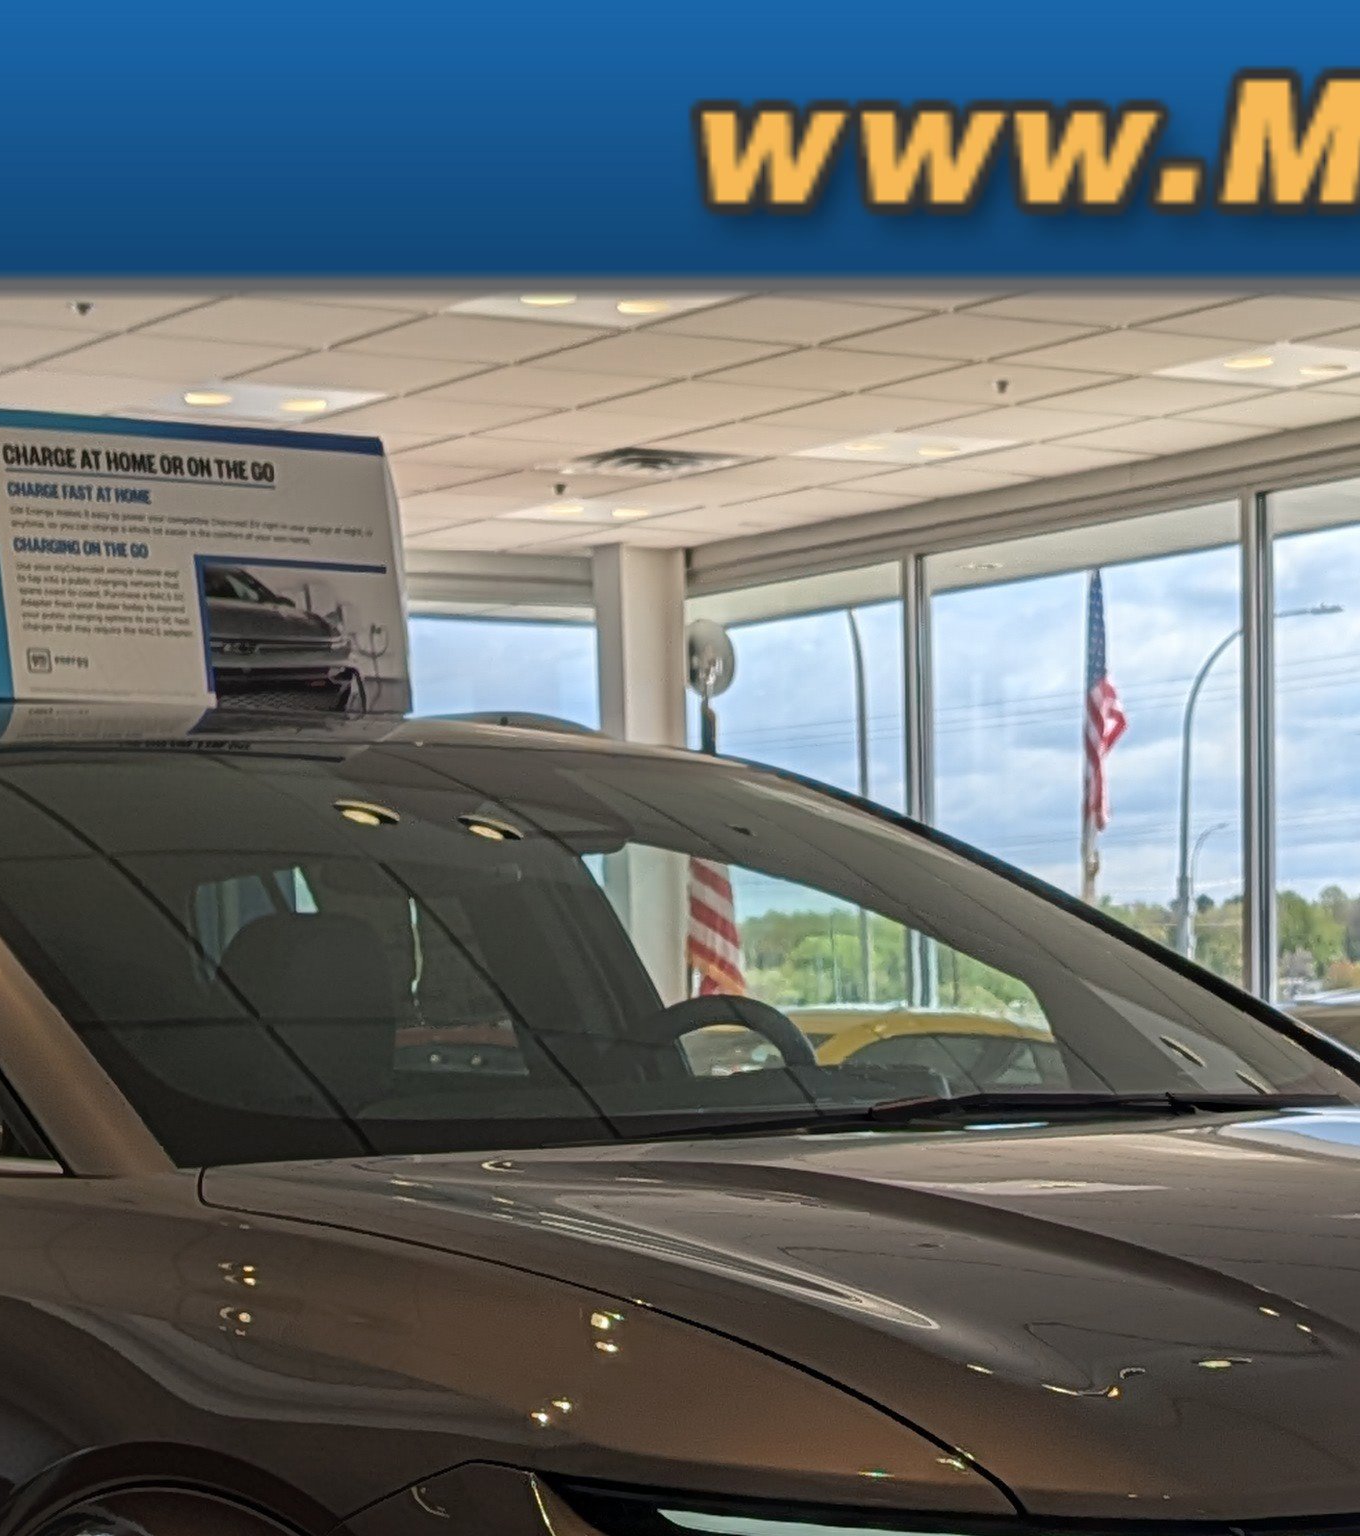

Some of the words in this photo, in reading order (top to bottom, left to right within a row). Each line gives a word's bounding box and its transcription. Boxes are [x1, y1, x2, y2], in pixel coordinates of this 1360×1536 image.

[3, 444, 76, 468] CHARGE
[81, 449, 101, 470] AT
[106, 450, 157, 474] HOME
[160, 454, 184, 475] OR
[187, 456, 211, 478] ON
[215, 458, 248, 480] THE
[251, 462, 275, 482] GO
[62, 485, 92, 500] FAST
[96, 486, 111, 502] AT
